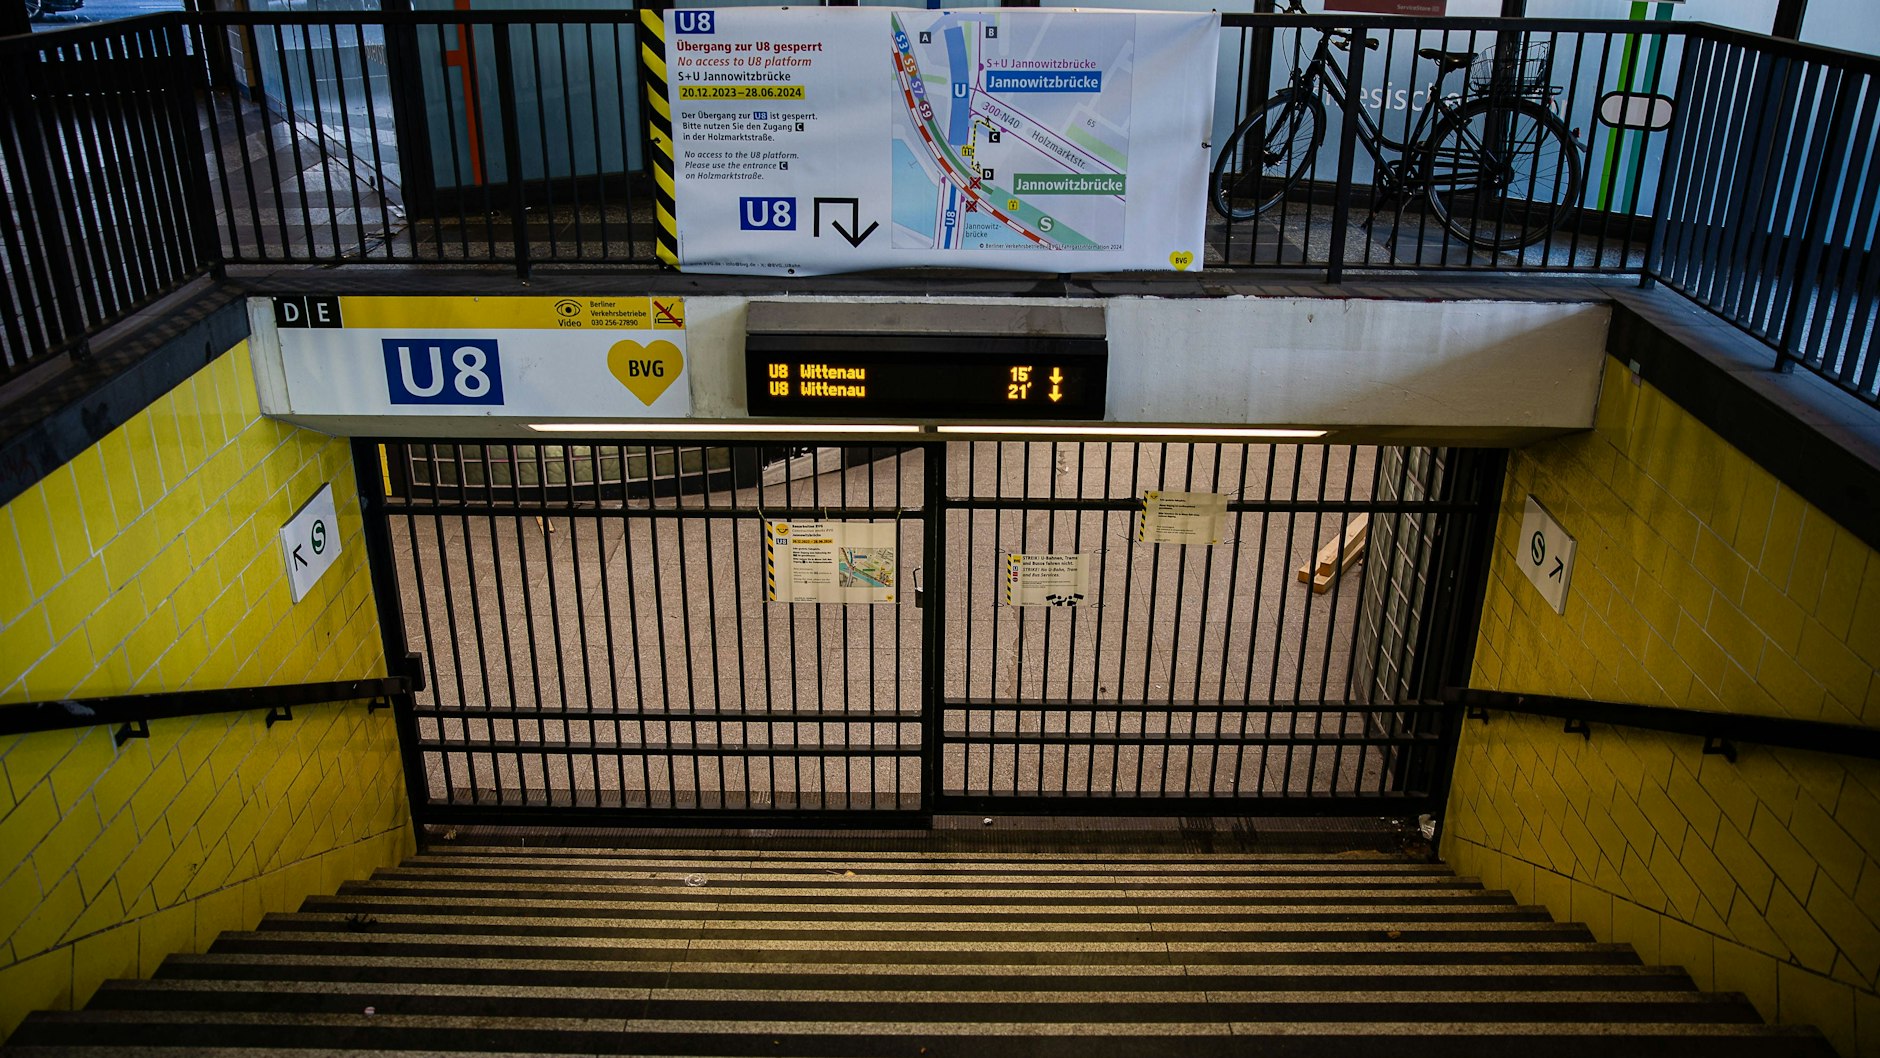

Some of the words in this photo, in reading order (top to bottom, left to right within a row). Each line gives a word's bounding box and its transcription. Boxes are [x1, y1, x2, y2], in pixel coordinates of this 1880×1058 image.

[679, 12, 711, 32] U8
[922, 33, 929, 42] A
[988, 28, 995, 37] B
[677, 40, 732, 53] Übergang
[735, 43, 753, 52] zur
[756, 41, 770, 51] U8
[773, 42, 823, 54] gesperrt
[896, 34, 908, 50] S3
[678, 57, 692, 67] No
[696, 59, 730, 67] access
[733, 58, 744, 67] to
[747, 57, 762, 67] U8
[764, 56, 812, 69] platform
[905, 56, 917, 73] S5
[986, 59, 1008, 68] S+U
[1011, 59, 1096, 69] Jannowitzbrücke
[678, 72, 700, 82] S+U
[703, 72, 791, 82] Jannowitzbrücke
[989, 76, 1099, 88] Jannowitzbrücke
[912, 78, 925, 95] S7
[955, 84, 966, 98] U
[698, 111, 736, 121] Übergang
[754, 112, 768, 120] U8
[782, 112, 818, 122] gesperrt.
[920, 102, 931, 120] S9
[683, 122, 702, 130] Bitte
[732, 123, 744, 131] Sie
[746, 123, 761, 131] den
[763, 124, 793, 133] Zugang
[796, 123, 804, 131] C
[1086, 118, 1096, 128] 65
[708, 134, 775, 142] Holzmarktstraße.
[990, 133, 998, 142] C
[685, 151, 696, 159] No
[762, 152, 800, 161] platform.
[1031, 130, 1086, 170] Holzmarktstr.
[685, 162, 710, 170] Please
[698, 172, 764, 180] Holzmarktstraße.
[984, 170, 992, 178] D
[1016, 178, 1122, 191] Jannowitzbrücke
[746, 200, 792, 228] U8
[946, 211, 956, 226] U8
[1040, 218, 1052, 232] S
[284, 302, 299, 322] D
[316, 302, 330, 322] E
[558, 319, 582, 327] Video
[397, 345, 491, 398] U8
[628, 360, 664, 377] BVG
[769, 364, 788, 379] U8
[800, 364, 866, 380] Wittenau
[770, 381, 788, 396] U8
[800, 382, 866, 398] Wittenau
